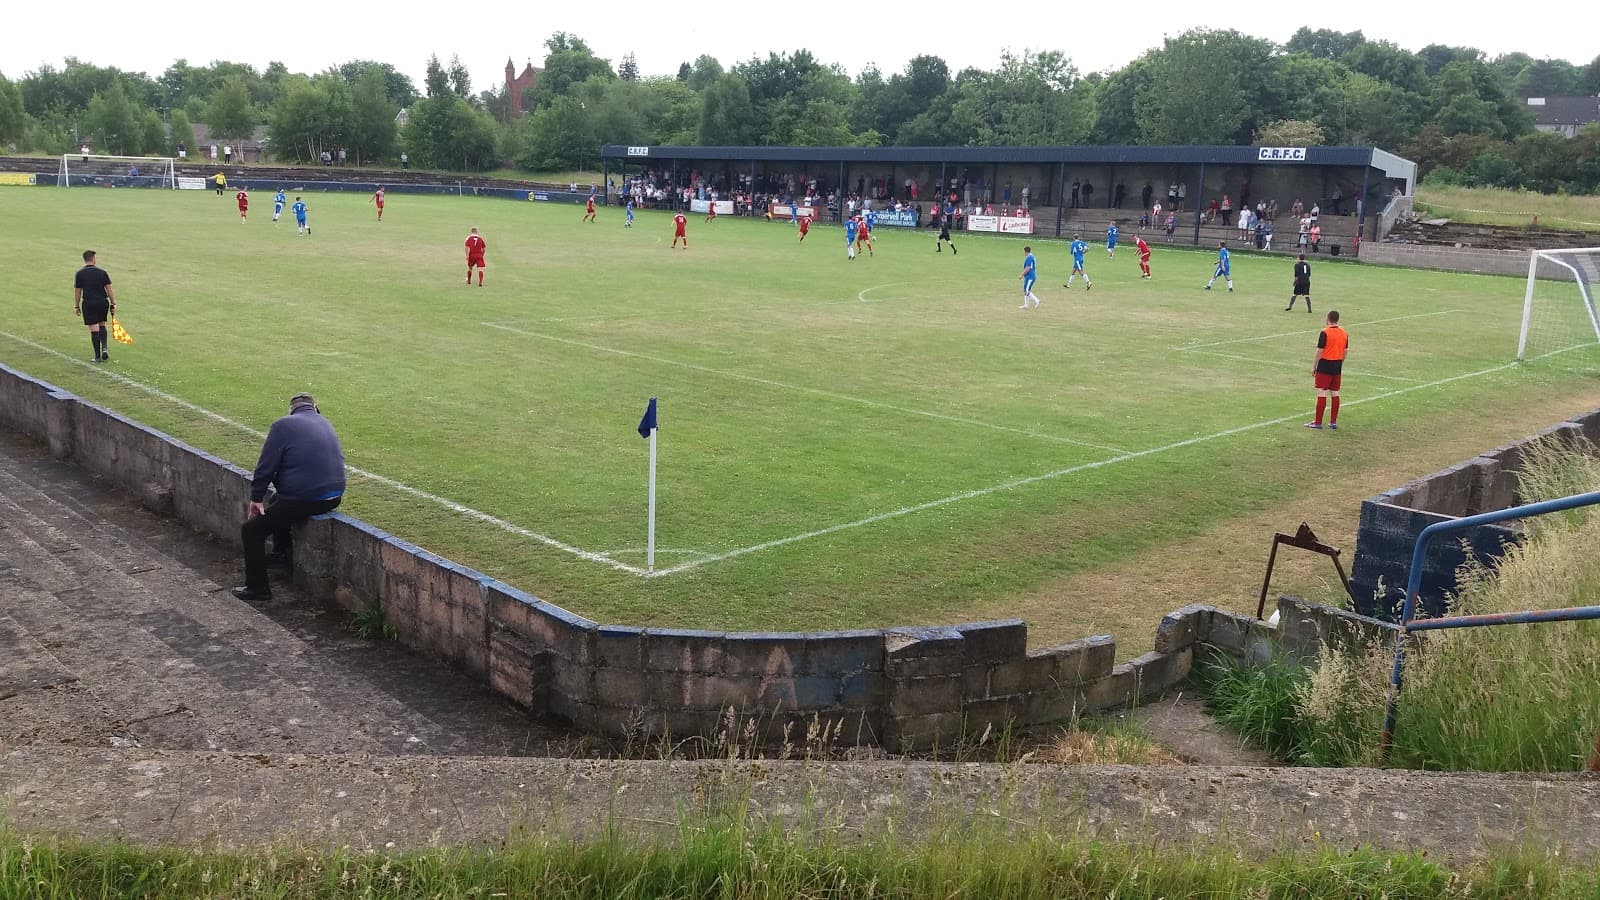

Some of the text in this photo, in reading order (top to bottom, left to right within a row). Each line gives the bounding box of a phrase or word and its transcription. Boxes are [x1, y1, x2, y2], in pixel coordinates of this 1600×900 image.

[1260, 149, 1304, 159] C.R.F.C.
[900, 211, 913, 221] Park
[473, 237, 478, 246] 7
